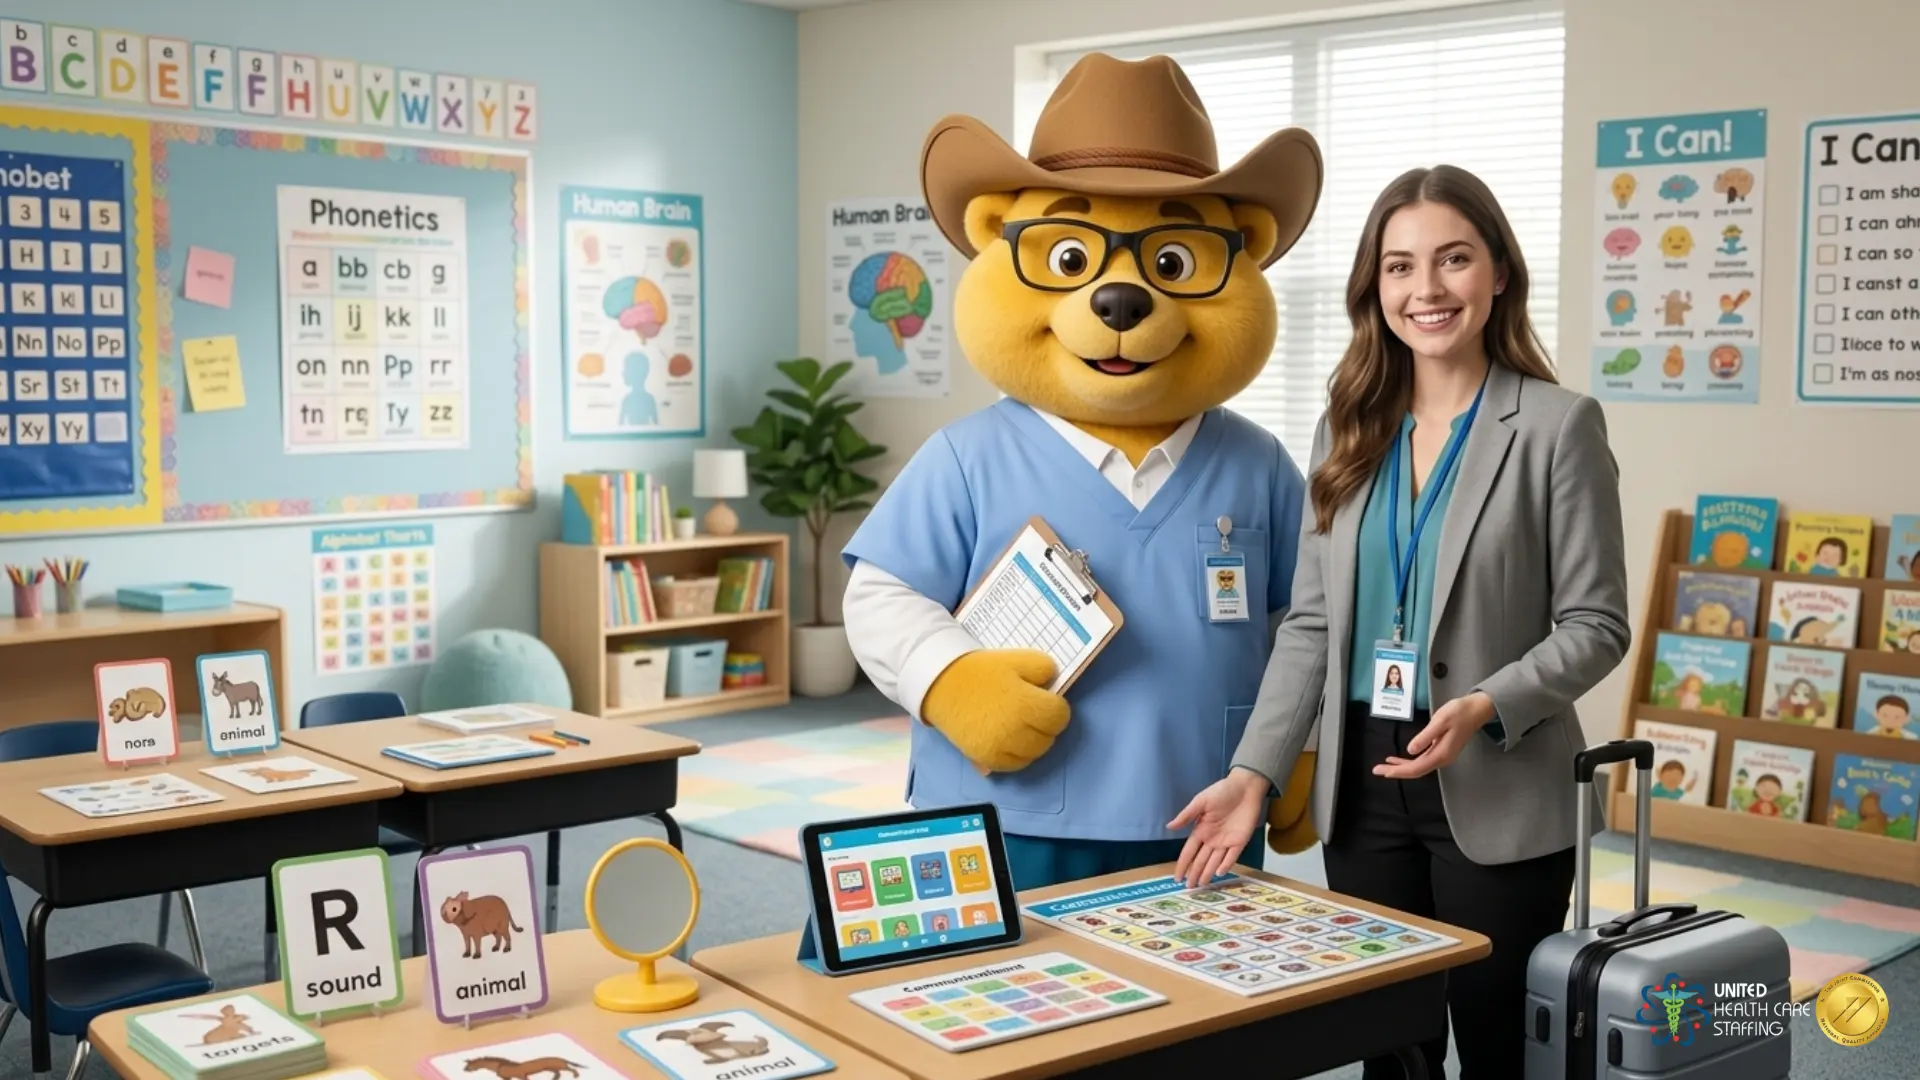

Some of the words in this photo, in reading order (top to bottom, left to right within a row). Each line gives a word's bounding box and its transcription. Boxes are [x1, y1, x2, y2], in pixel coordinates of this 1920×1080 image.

[16, 24, 28, 40] b
[67, 34, 78, 47] c
[116, 39, 127, 53] d
[163, 46, 174, 58] e
[208, 50, 216, 64] f
[252, 58, 262, 72] g
[294, 60, 304, 74] h
[10, 46, 37, 83] B
[60, 52, 87, 90] C
[109, 58, 136, 94] D
[158, 63, 180, 99] E
[204, 69, 224, 103] F
[248, 74, 268, 107] F
[287, 78, 310, 114] H
[328, 84, 350, 117] U
[366, 88, 390, 120] V
[401, 92, 430, 124] W
[442, 97, 462, 128] X
[478, 101, 498, 133] Y
[514, 105, 530, 136] Z
[1624, 126, 1644, 159] I
[1654, 119, 1732, 157] Can!
[1820, 134, 1838, 166] I
[1852, 132, 1920, 164] Can
[1846, 186, 1854, 201] I
[1860, 188, 1885, 200] am
[20, 204, 31, 220] 3
[60, 206, 70, 222] 4
[100, 208, 110, 226] 5
[310, 198, 439, 231] Phonetics
[573, 192, 640, 218] Human
[644, 198, 692, 220] Brain
[832, 206, 890, 227] Human
[1845, 216, 1853, 231] I
[1859, 219, 1888, 230] can
[20, 247, 34, 264] H
[102, 250, 110, 269] J
[1844, 246, 1852, 261] I
[1858, 248, 1887, 260] can
[1894, 248, 1914, 260] so
[302, 260, 318, 277] a
[338, 256, 368, 278] bb
[383, 259, 411, 280] cb
[432, 264, 446, 285] g
[1843, 276, 1850, 291] I
[1856, 276, 1902, 290] canst
[1908, 278, 1918, 290] a
[22, 291, 35, 306] K
[300, 304, 321, 326] ih
[348, 304, 361, 332] ij
[386, 306, 411, 328] kk
[1842, 306, 1850, 321] I
[1856, 310, 1884, 320] can
[16, 334, 42, 350] Nn
[58, 336, 82, 351] No
[98, 336, 120, 354] Pp
[1888, 338, 1906, 351] to
[297, 358, 326, 376] on
[342, 358, 370, 375] nn
[385, 355, 412, 380] Pp
[430, 360, 452, 374] rr
[1871, 370, 1889, 381] as
[21, 378, 42, 394] Sr
[61, 377, 81, 394] St
[101, 377, 119, 393] Tt
[21, 422, 44, 440] Xy
[61, 422, 84, 439] Yy
[310, 888, 366, 957] R
[306, 965, 382, 998] sound
[456, 970, 526, 1000] animal
[716, 1056, 796, 1080] animal
